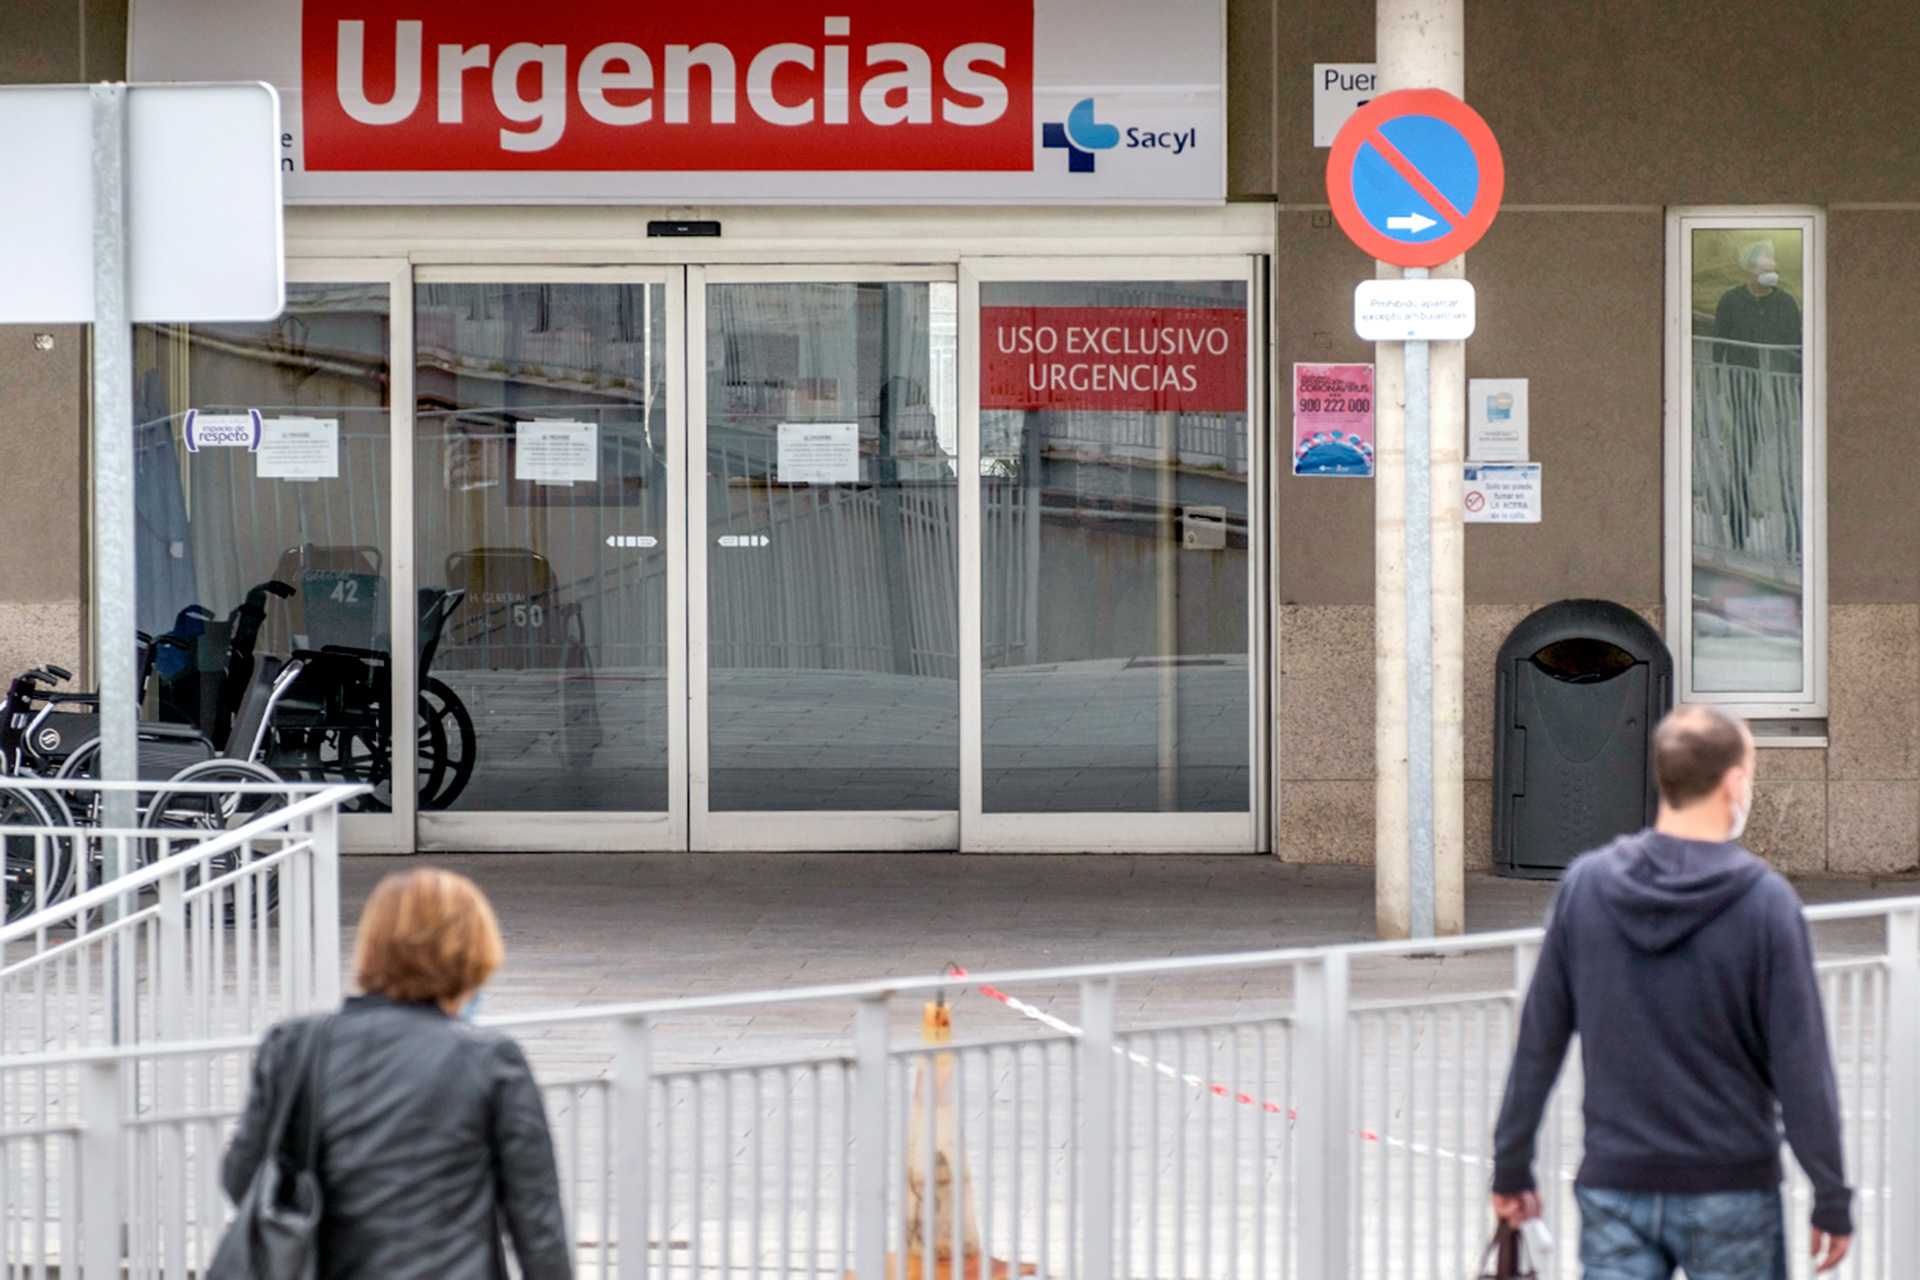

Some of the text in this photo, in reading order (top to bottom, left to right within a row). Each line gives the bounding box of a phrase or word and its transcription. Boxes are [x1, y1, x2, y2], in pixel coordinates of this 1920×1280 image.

[337, 16, 1009, 152] Urgencias
[1325, 69, 1377, 91] Puer
[1126, 127, 1196, 154] Sacyl
[998, 326, 1229, 355] USO EXCLUSIVO
[1028, 363, 1198, 392] URGENCIAS
[1300, 384, 1369, 392] CORONAVIRUS
[1300, 398, 1370, 412] 900 222 000
[199, 431, 249, 444] respeto
[202, 425, 233, 433] espacio
[330, 580, 358, 603] 42
[514, 604, 543, 627] 50
